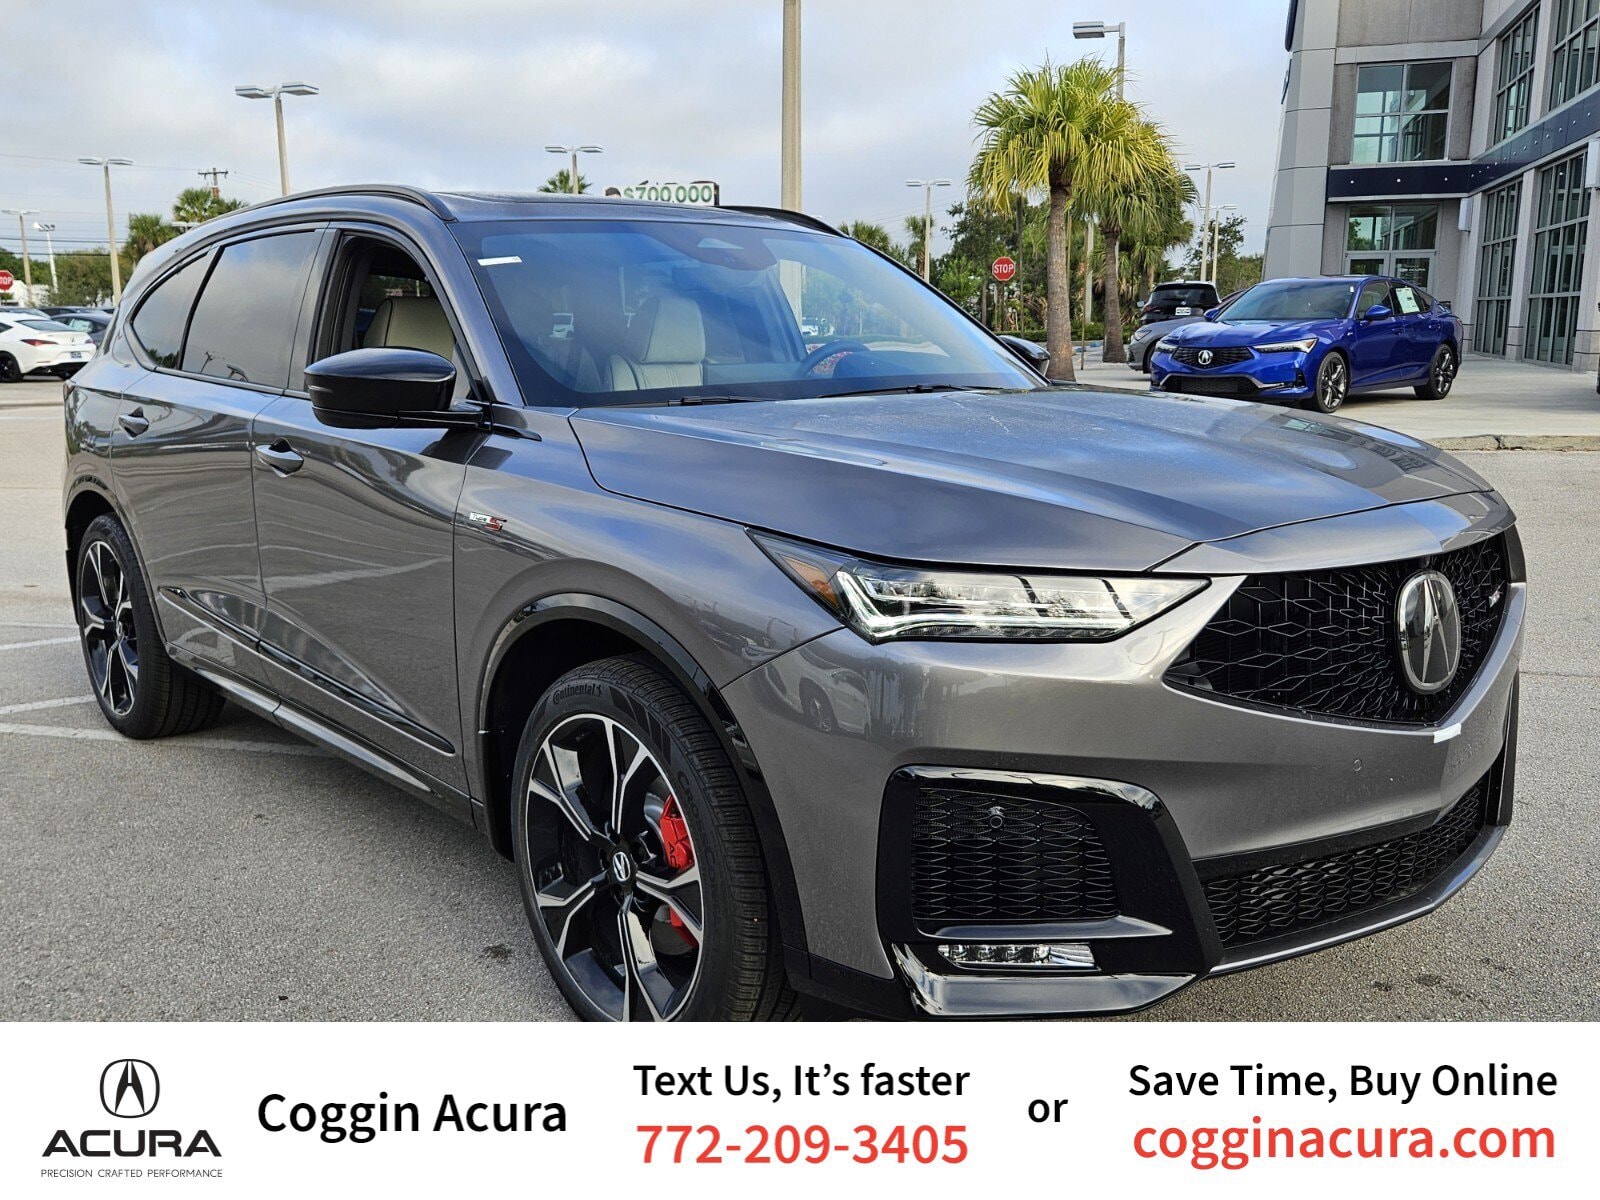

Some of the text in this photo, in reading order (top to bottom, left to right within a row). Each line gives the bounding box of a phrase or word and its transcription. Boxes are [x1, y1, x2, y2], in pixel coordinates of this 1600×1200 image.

[994, 264, 1014, 273] STOP
[0, 276, 12, 285] TOP
[553, 683, 596, 705] Continental
